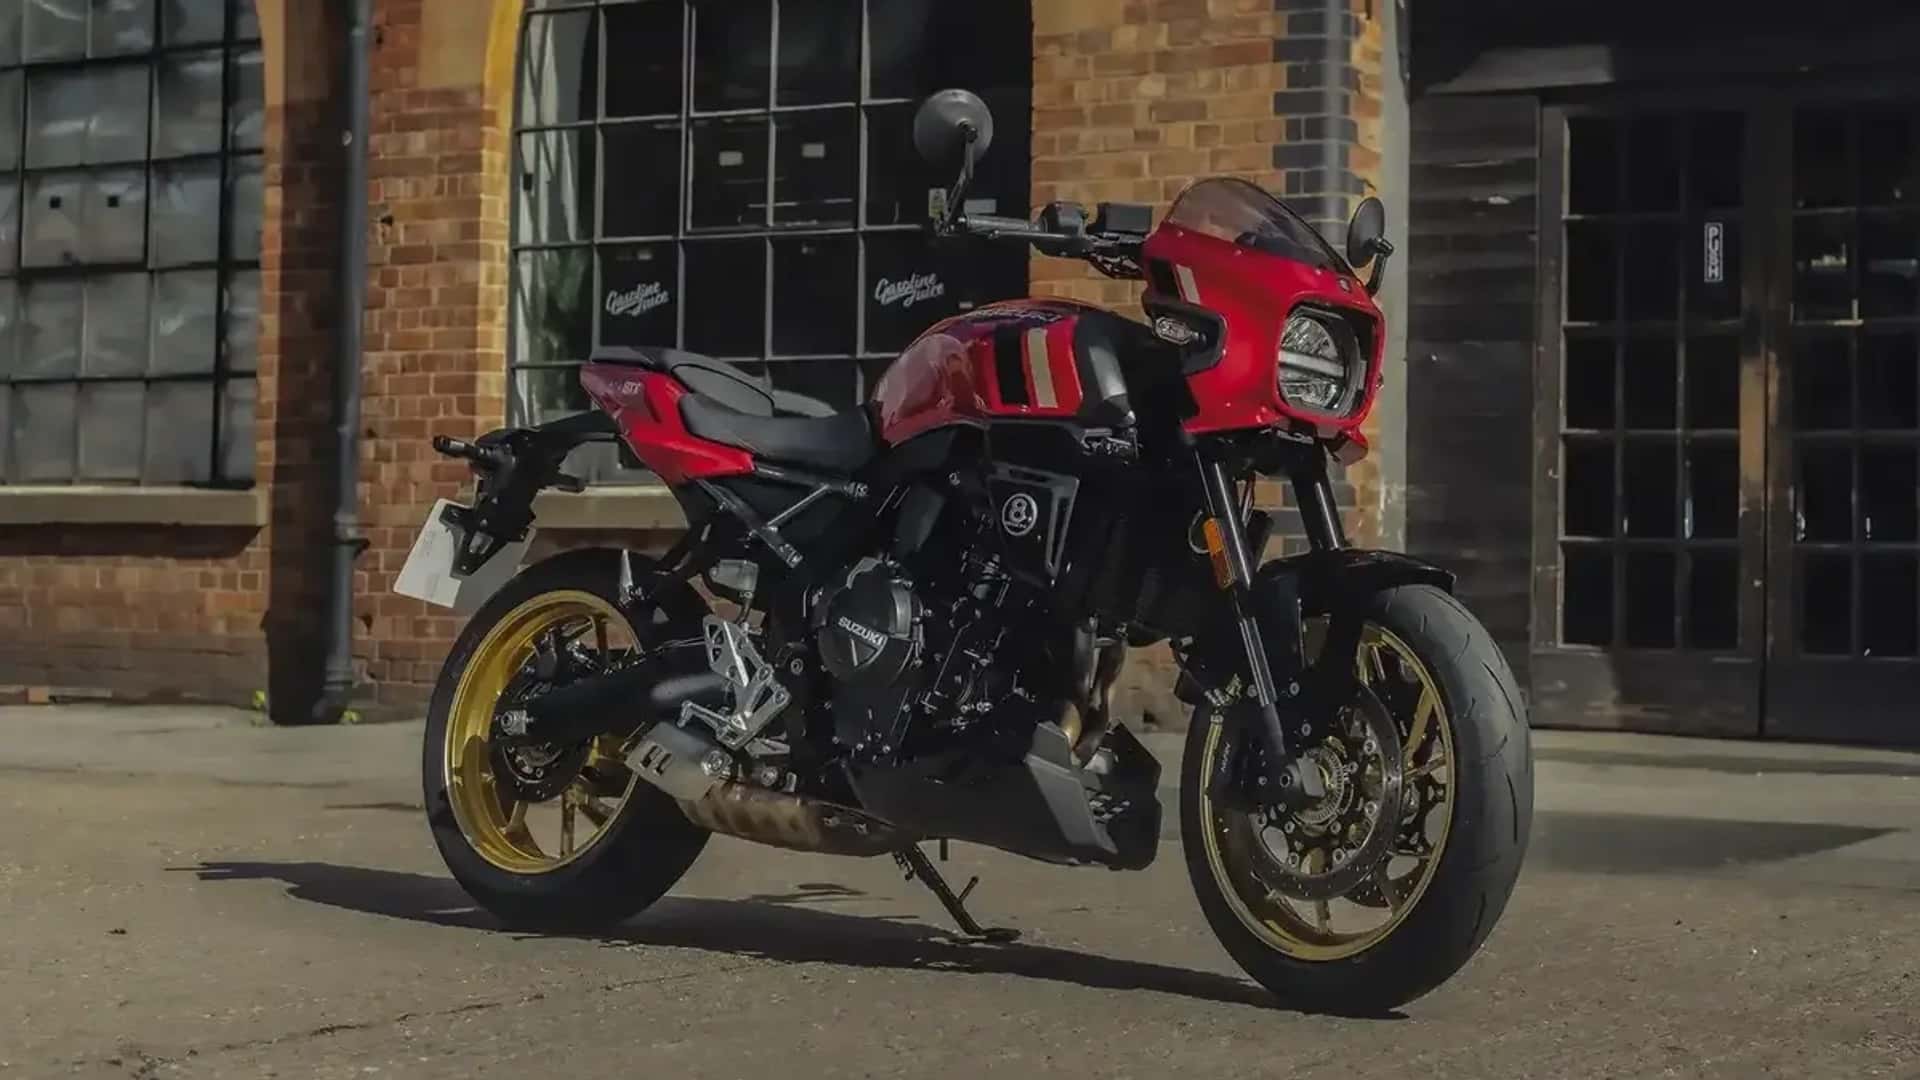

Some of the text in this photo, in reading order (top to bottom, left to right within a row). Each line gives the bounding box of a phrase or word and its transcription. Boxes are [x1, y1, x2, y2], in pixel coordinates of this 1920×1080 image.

[1708, 226, 1719, 278] PUSH
[605, 281, 661, 315] Gasoline
[874, 272, 937, 306] Gasoline
[838, 616, 884, 646] SUZUKI
